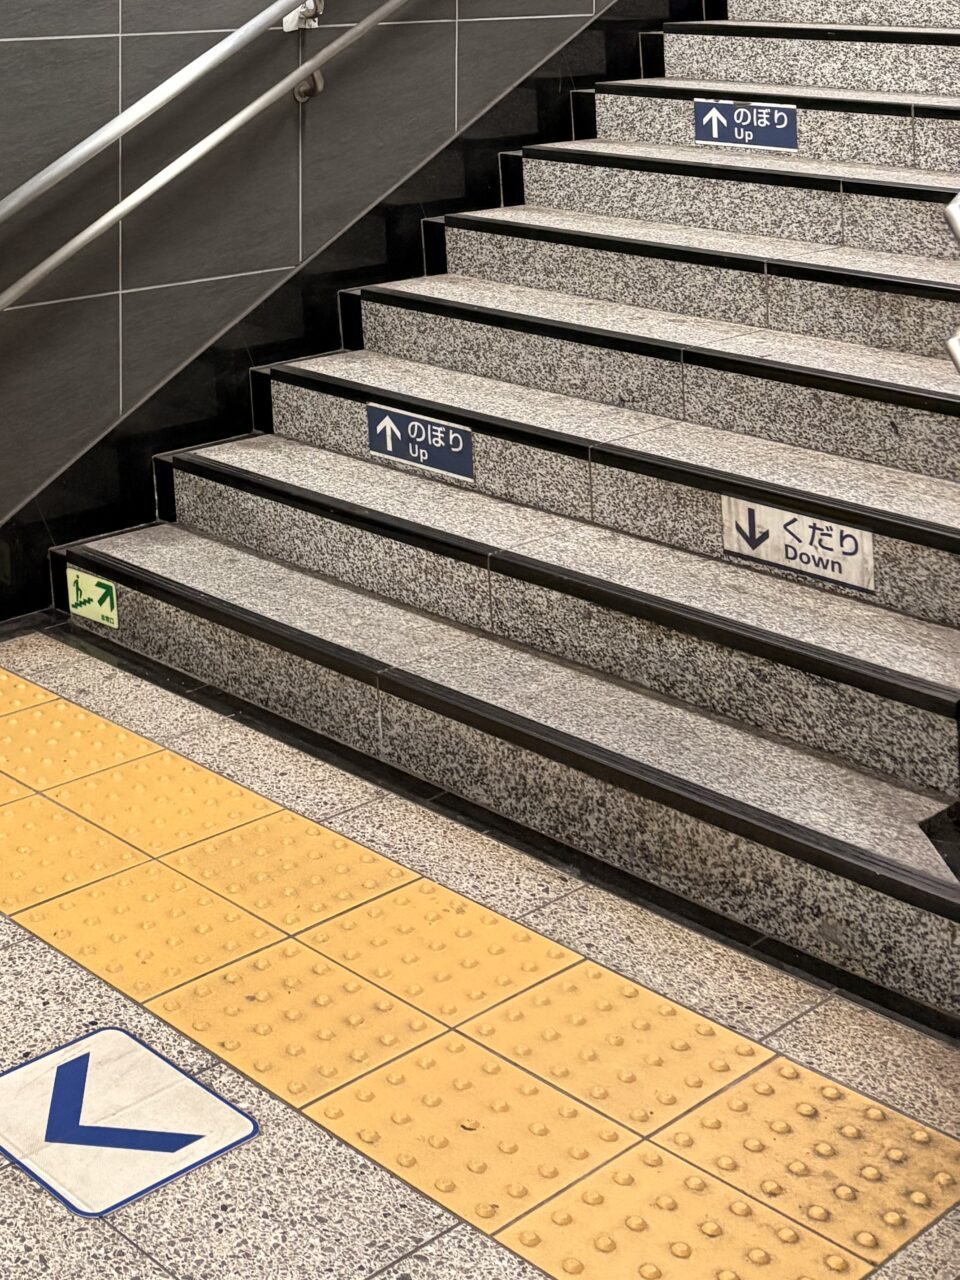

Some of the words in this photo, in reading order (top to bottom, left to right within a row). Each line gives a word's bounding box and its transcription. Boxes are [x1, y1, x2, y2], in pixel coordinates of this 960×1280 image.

[733, 107, 789, 129] のぼり
[734, 126, 754, 143] Up
[407, 420, 464, 453] のぼり
[408, 442, 429, 463] Up
[782, 516, 860, 557] くだり
[784, 543, 844, 575] Down
